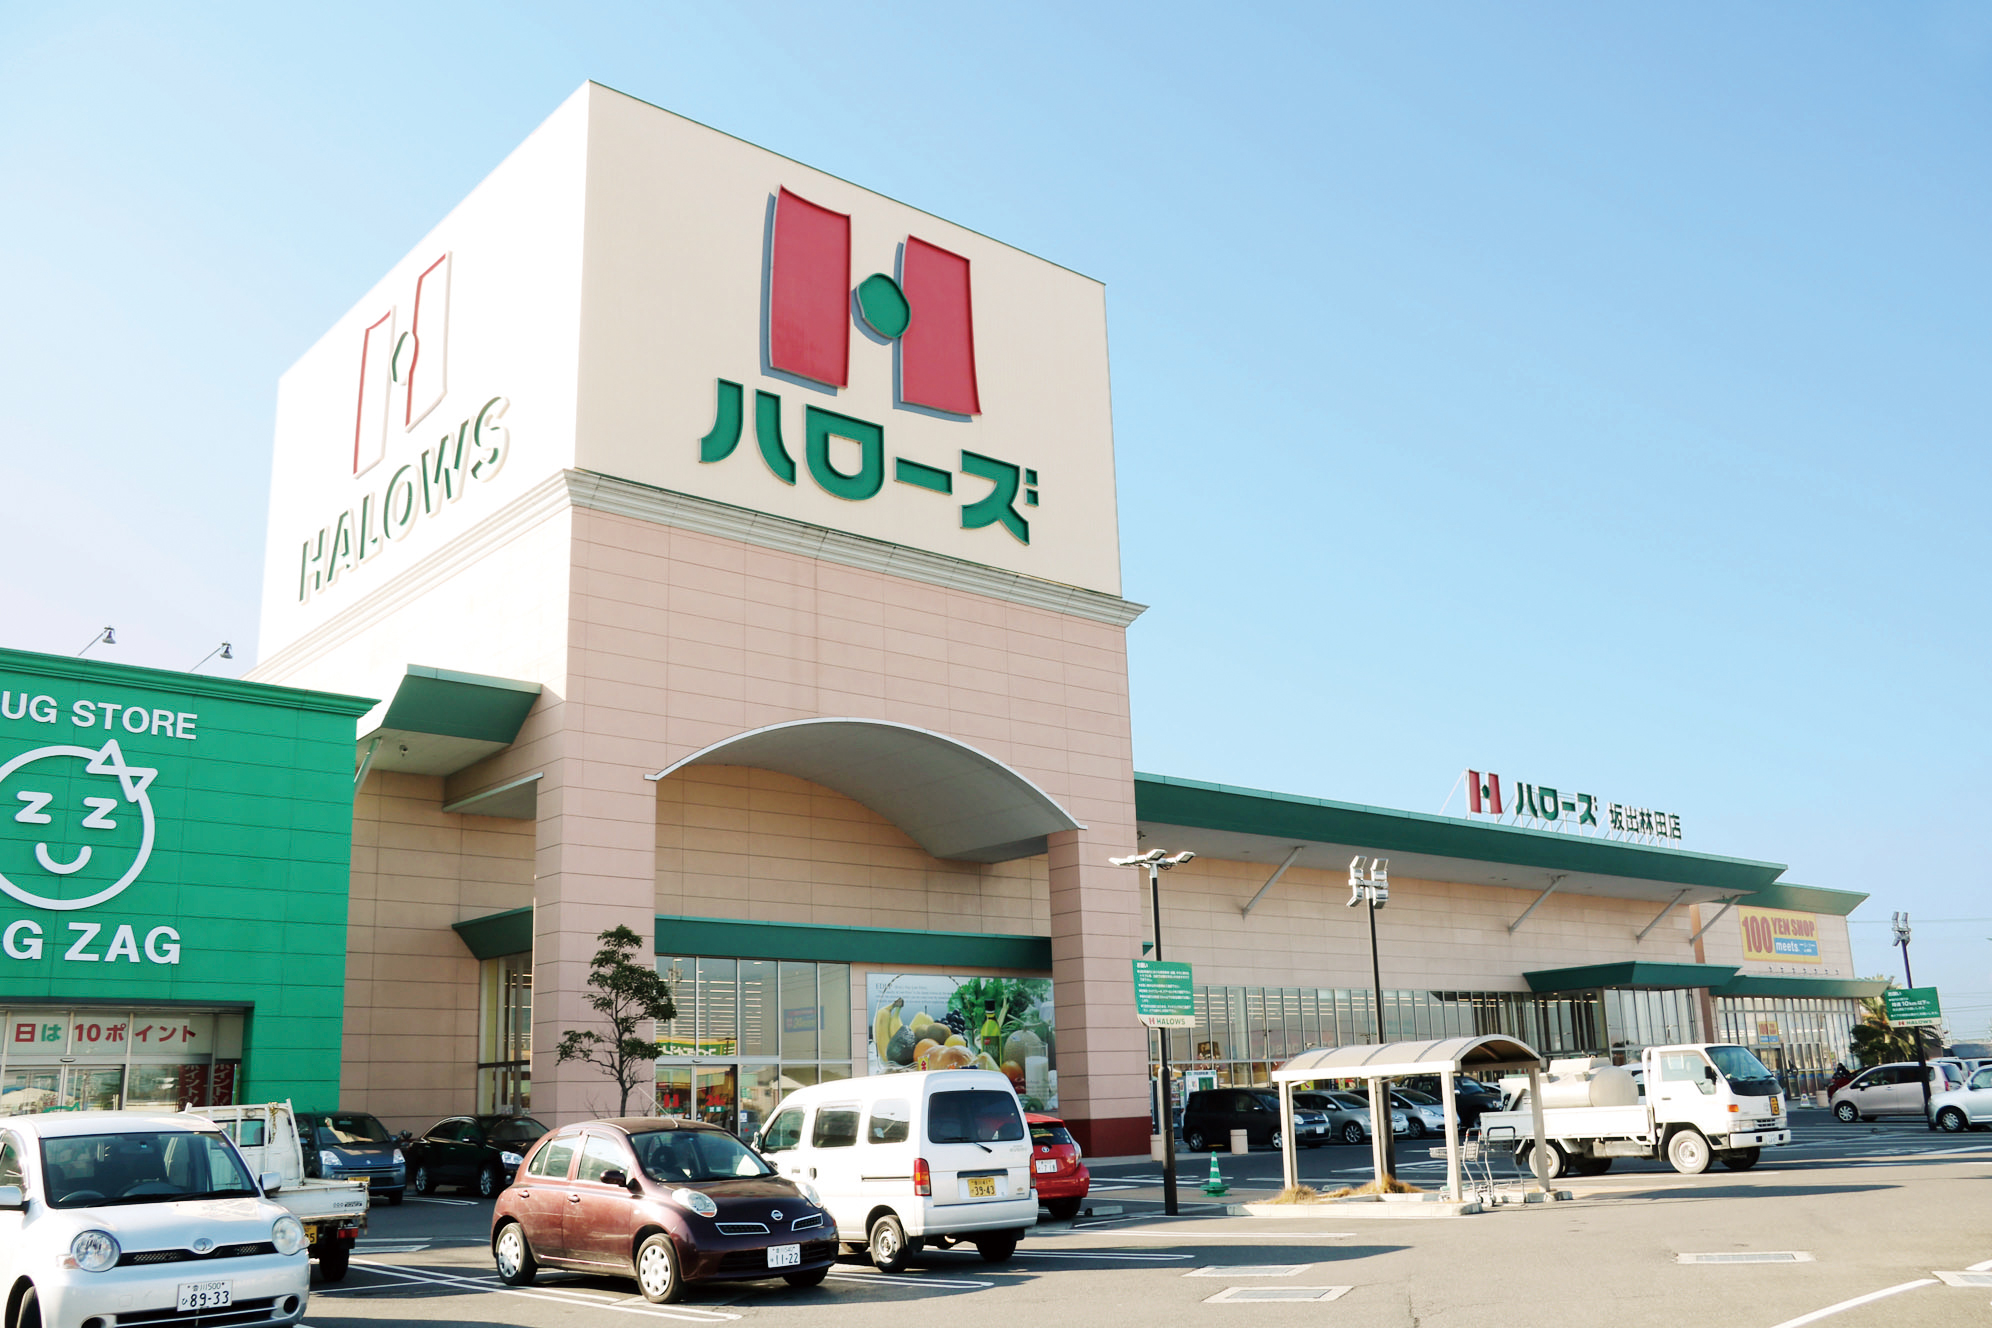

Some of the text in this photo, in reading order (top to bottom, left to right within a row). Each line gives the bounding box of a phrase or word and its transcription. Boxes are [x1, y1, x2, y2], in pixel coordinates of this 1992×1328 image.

[698, 377, 1039, 546] ハローズ
[299, 395, 510, 605] HALOWS
[71, 700, 198, 740] STORE
[1513, 781, 1597, 827] ハローズ
[1608, 803, 1682, 840] 坂出林田店
[64, 921, 181, 965] ZAG
[1742, 915, 1773, 954] 100
[1771, 917, 1815, 938] YEN SHOP
[974, 1185, 995, 1195] 39-43
[775, 1252, 799, 1265] 11-22
[190, 1290, 230, 1308] 89-33
